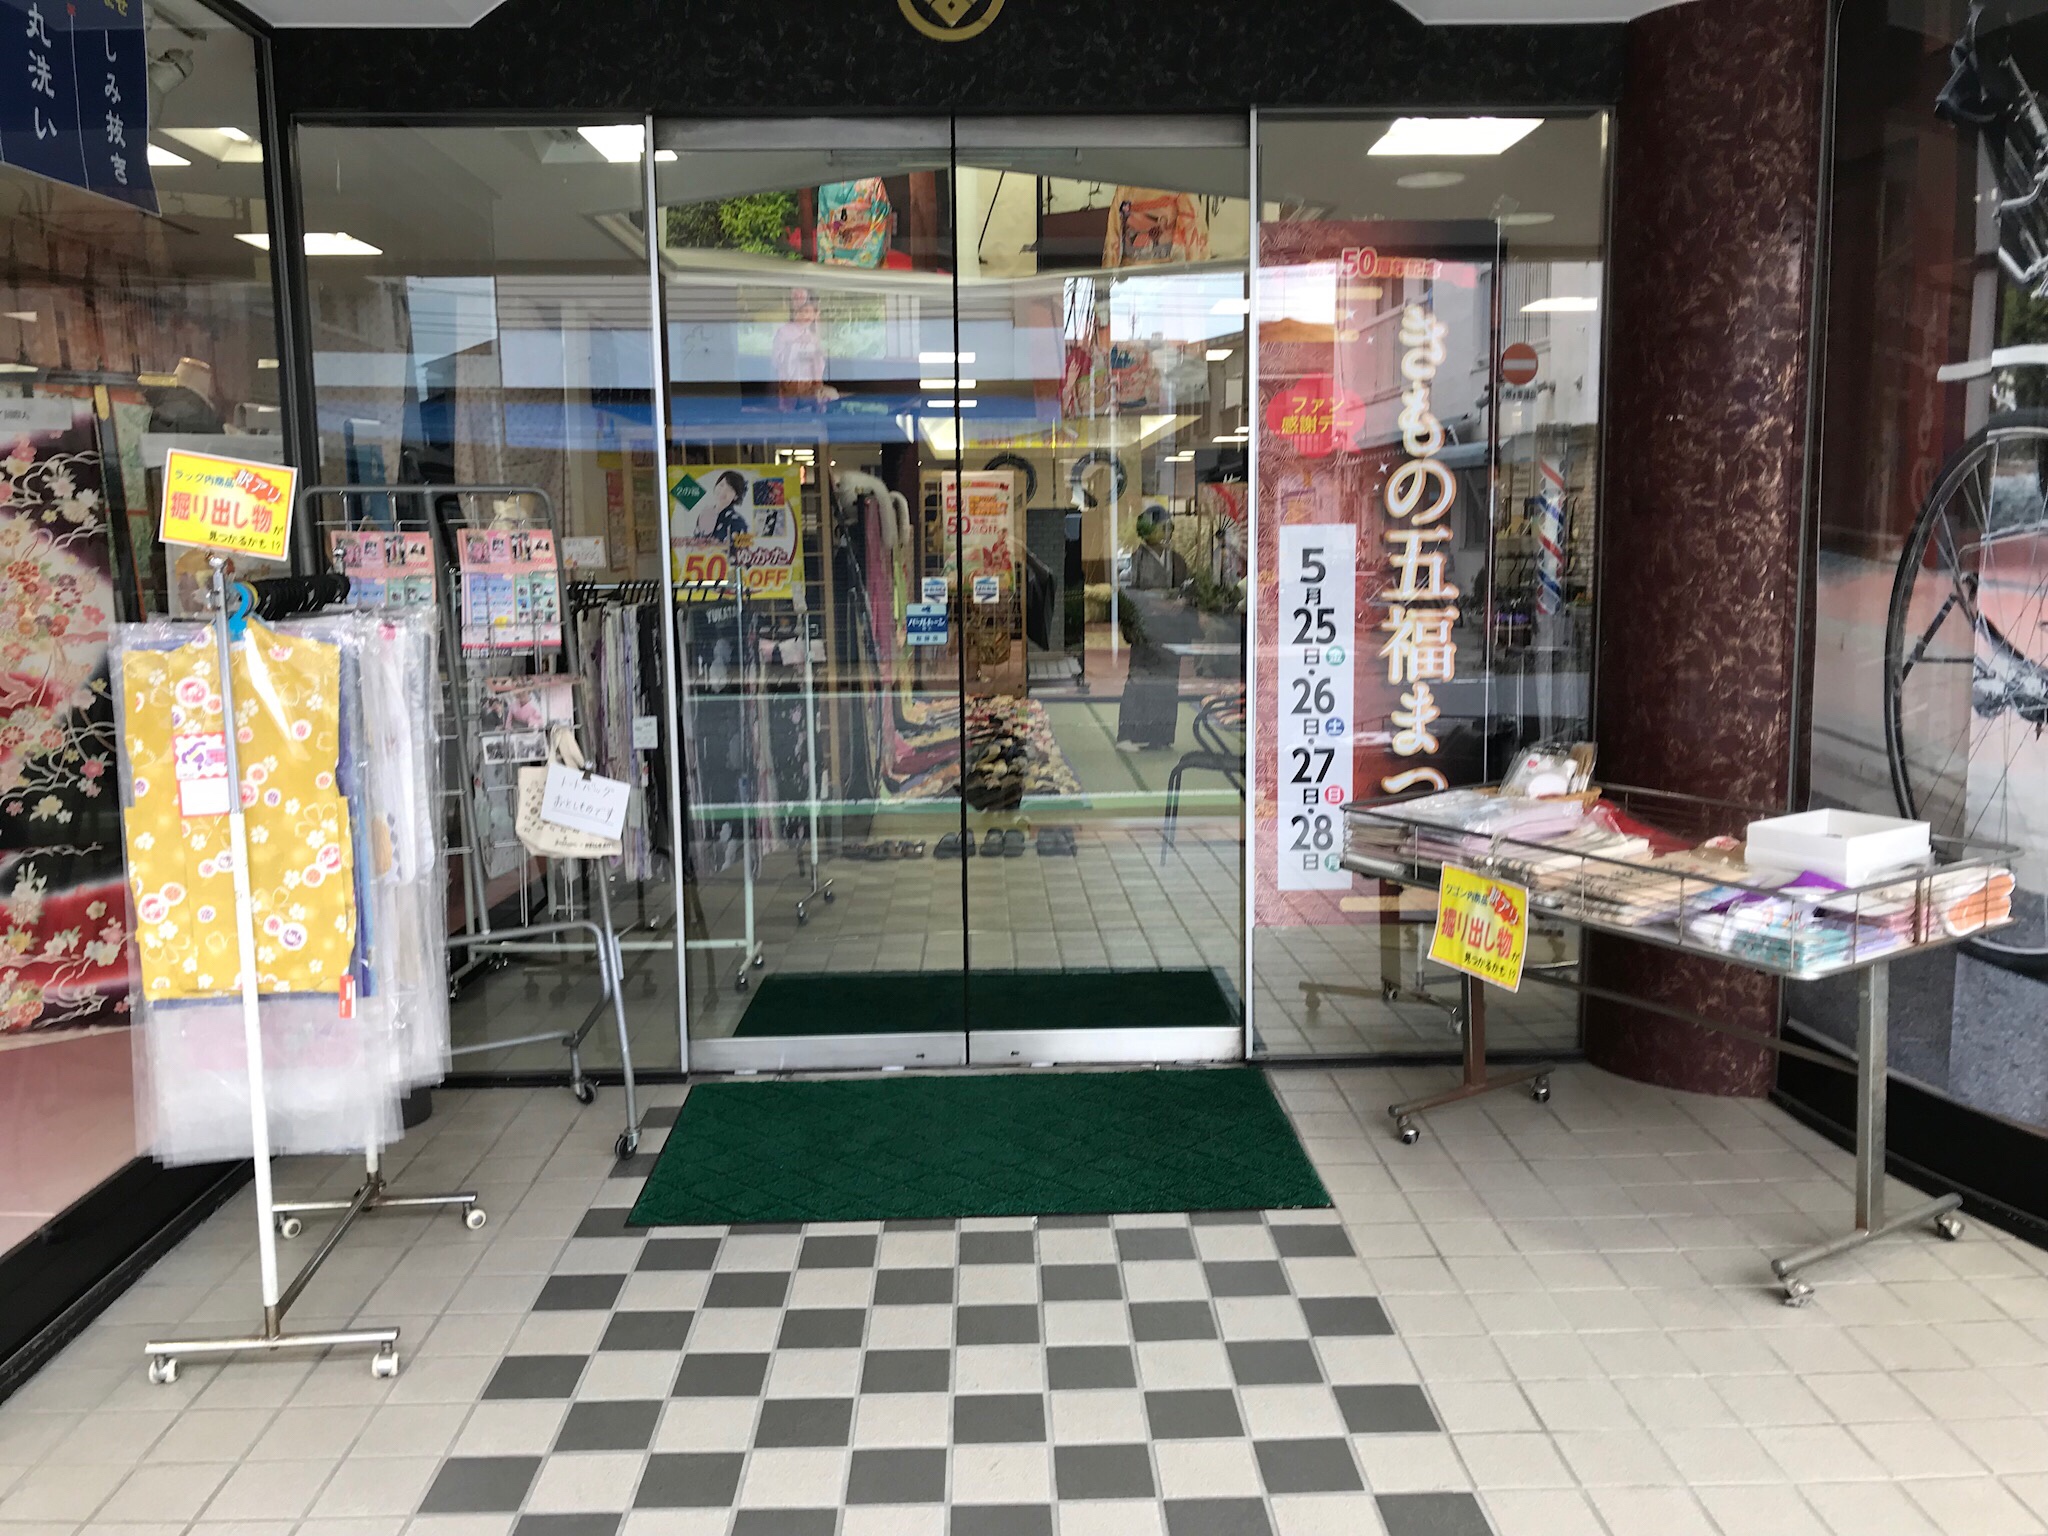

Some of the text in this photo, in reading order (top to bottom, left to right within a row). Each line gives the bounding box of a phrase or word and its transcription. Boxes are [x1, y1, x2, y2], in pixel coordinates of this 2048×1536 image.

[26, 2, 58, 140] 丸洗い
[103, 29, 128, 185] しみ抜き
